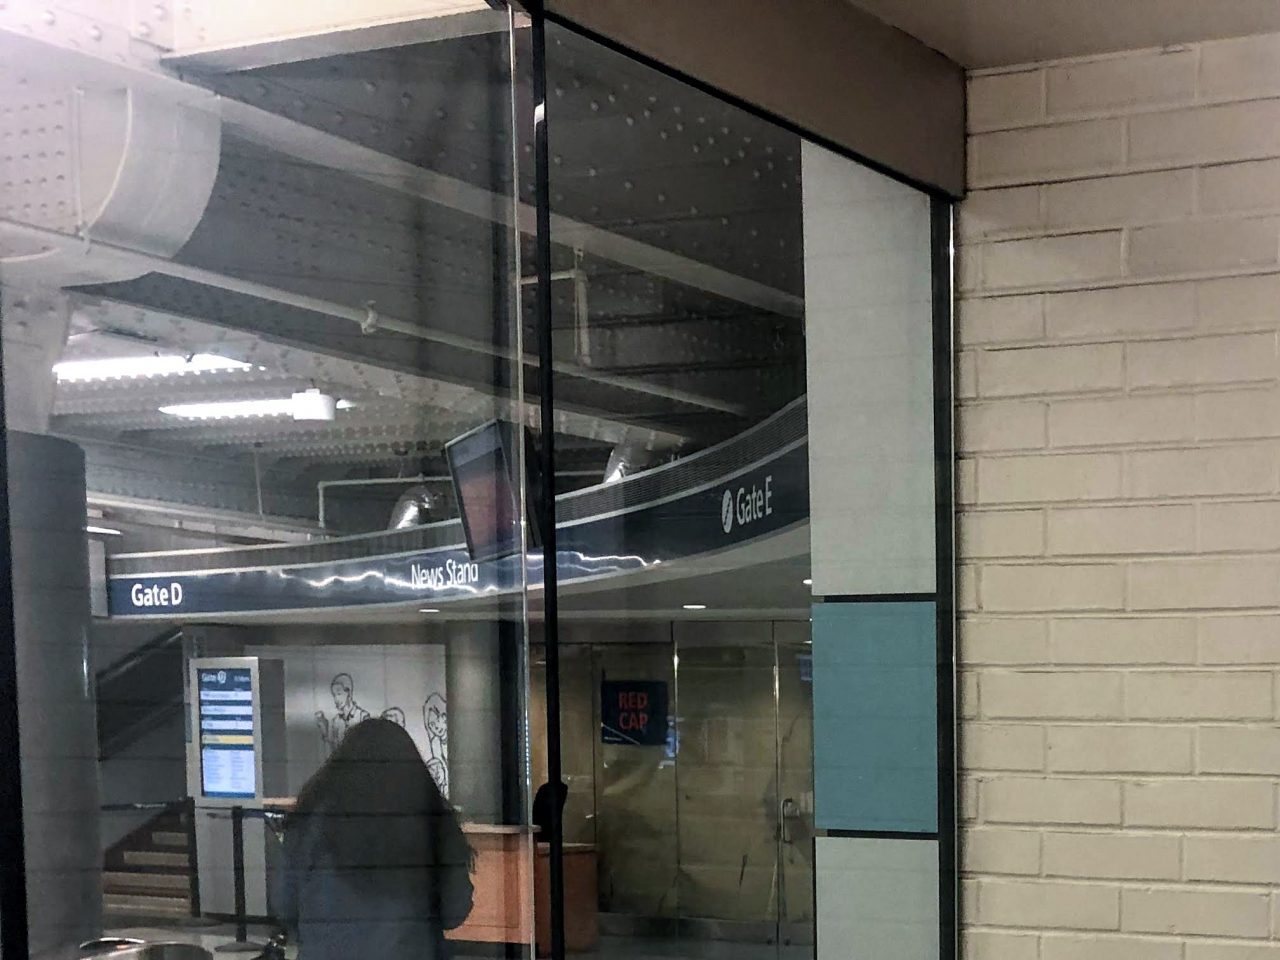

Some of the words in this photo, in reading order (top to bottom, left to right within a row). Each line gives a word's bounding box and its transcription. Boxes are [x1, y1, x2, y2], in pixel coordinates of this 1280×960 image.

[736, 486, 763, 525] Gate
[765, 476, 773, 515] E
[411, 563, 444, 586] News
[132, 584, 168, 607] Gate
[171, 583, 182, 605] D
[618, 692, 648, 709] RED
[619, 712, 648, 730] CAP
